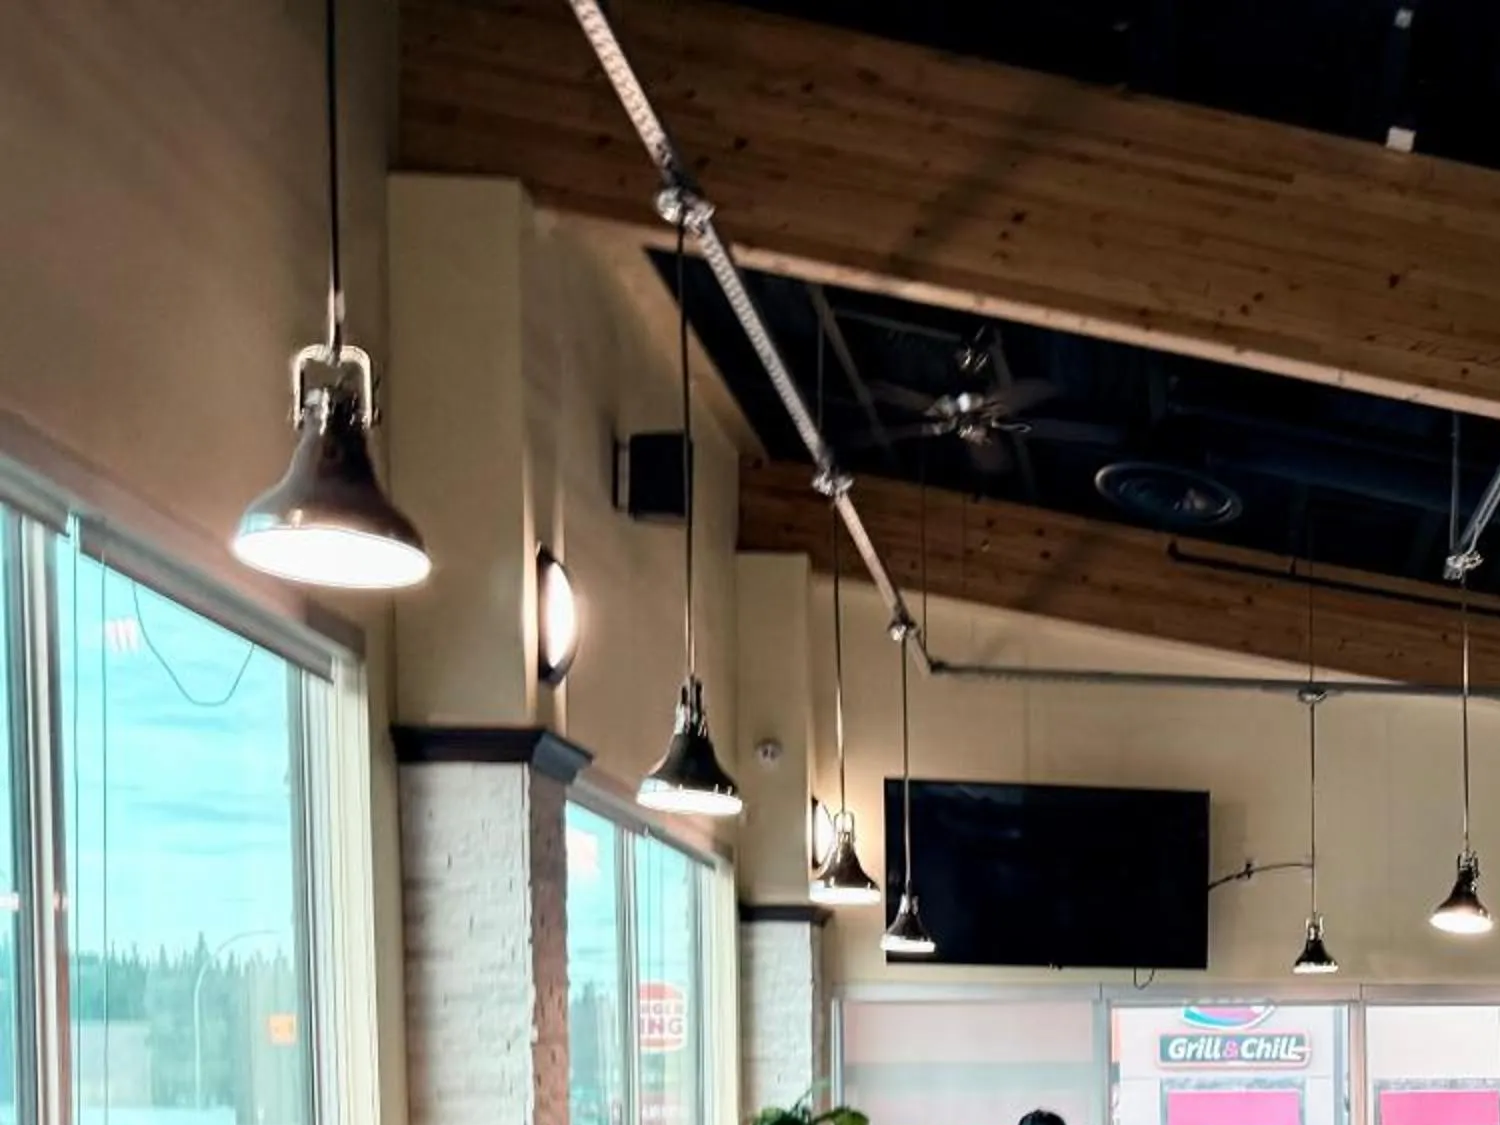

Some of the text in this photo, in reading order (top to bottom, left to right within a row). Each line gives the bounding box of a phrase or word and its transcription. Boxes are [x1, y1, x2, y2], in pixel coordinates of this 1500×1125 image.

[640, 1017, 684, 1036] ING
[1168, 1036, 1302, 1060] Grill & Chill
